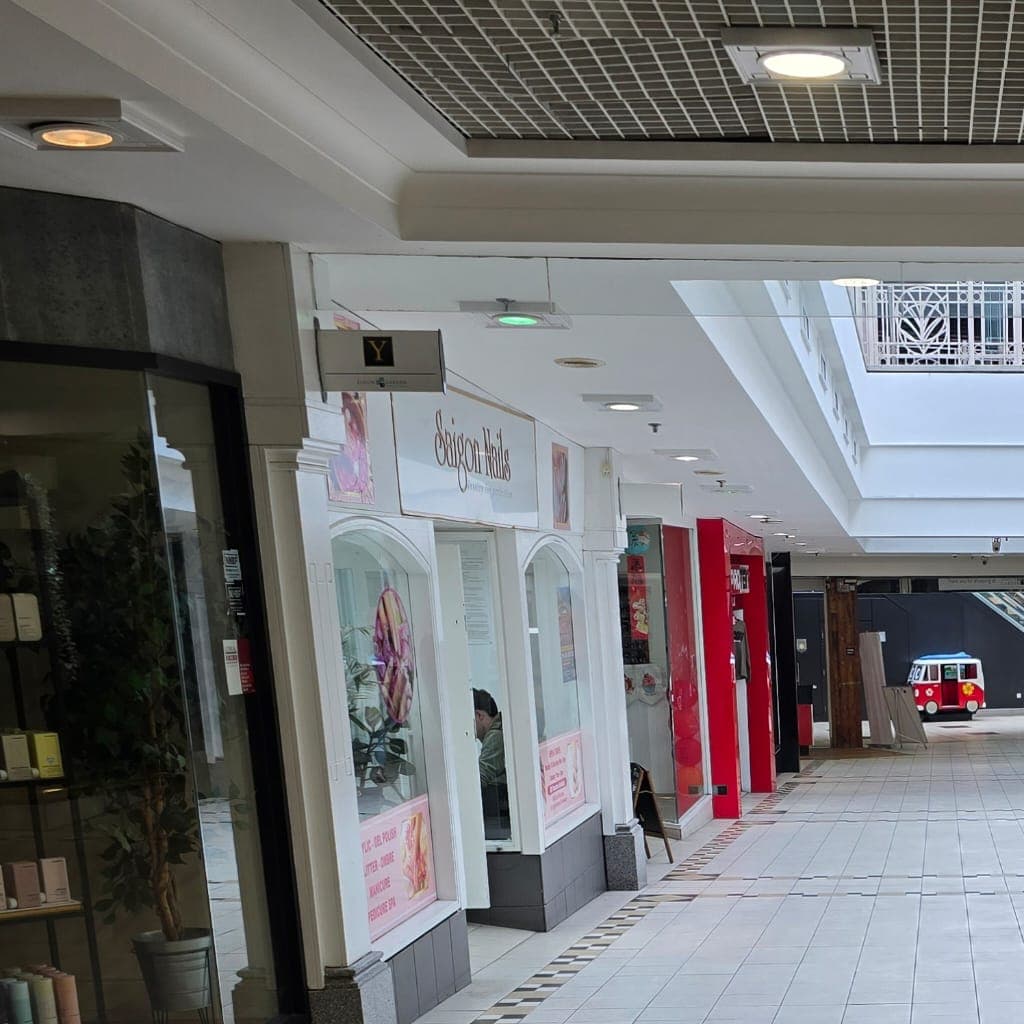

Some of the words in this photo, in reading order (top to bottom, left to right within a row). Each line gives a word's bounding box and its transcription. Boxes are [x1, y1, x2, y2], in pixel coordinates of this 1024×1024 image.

[368, 340, 387, 362] Y
[435, 408, 482, 493] Saigon
[482, 426, 511, 482] Nails
[374, 834, 384, 849] GEL
[382, 826, 397, 844] POLISH
[380, 851, 395, 869] OMBRE
[369, 876, 391, 898] MANICURE
